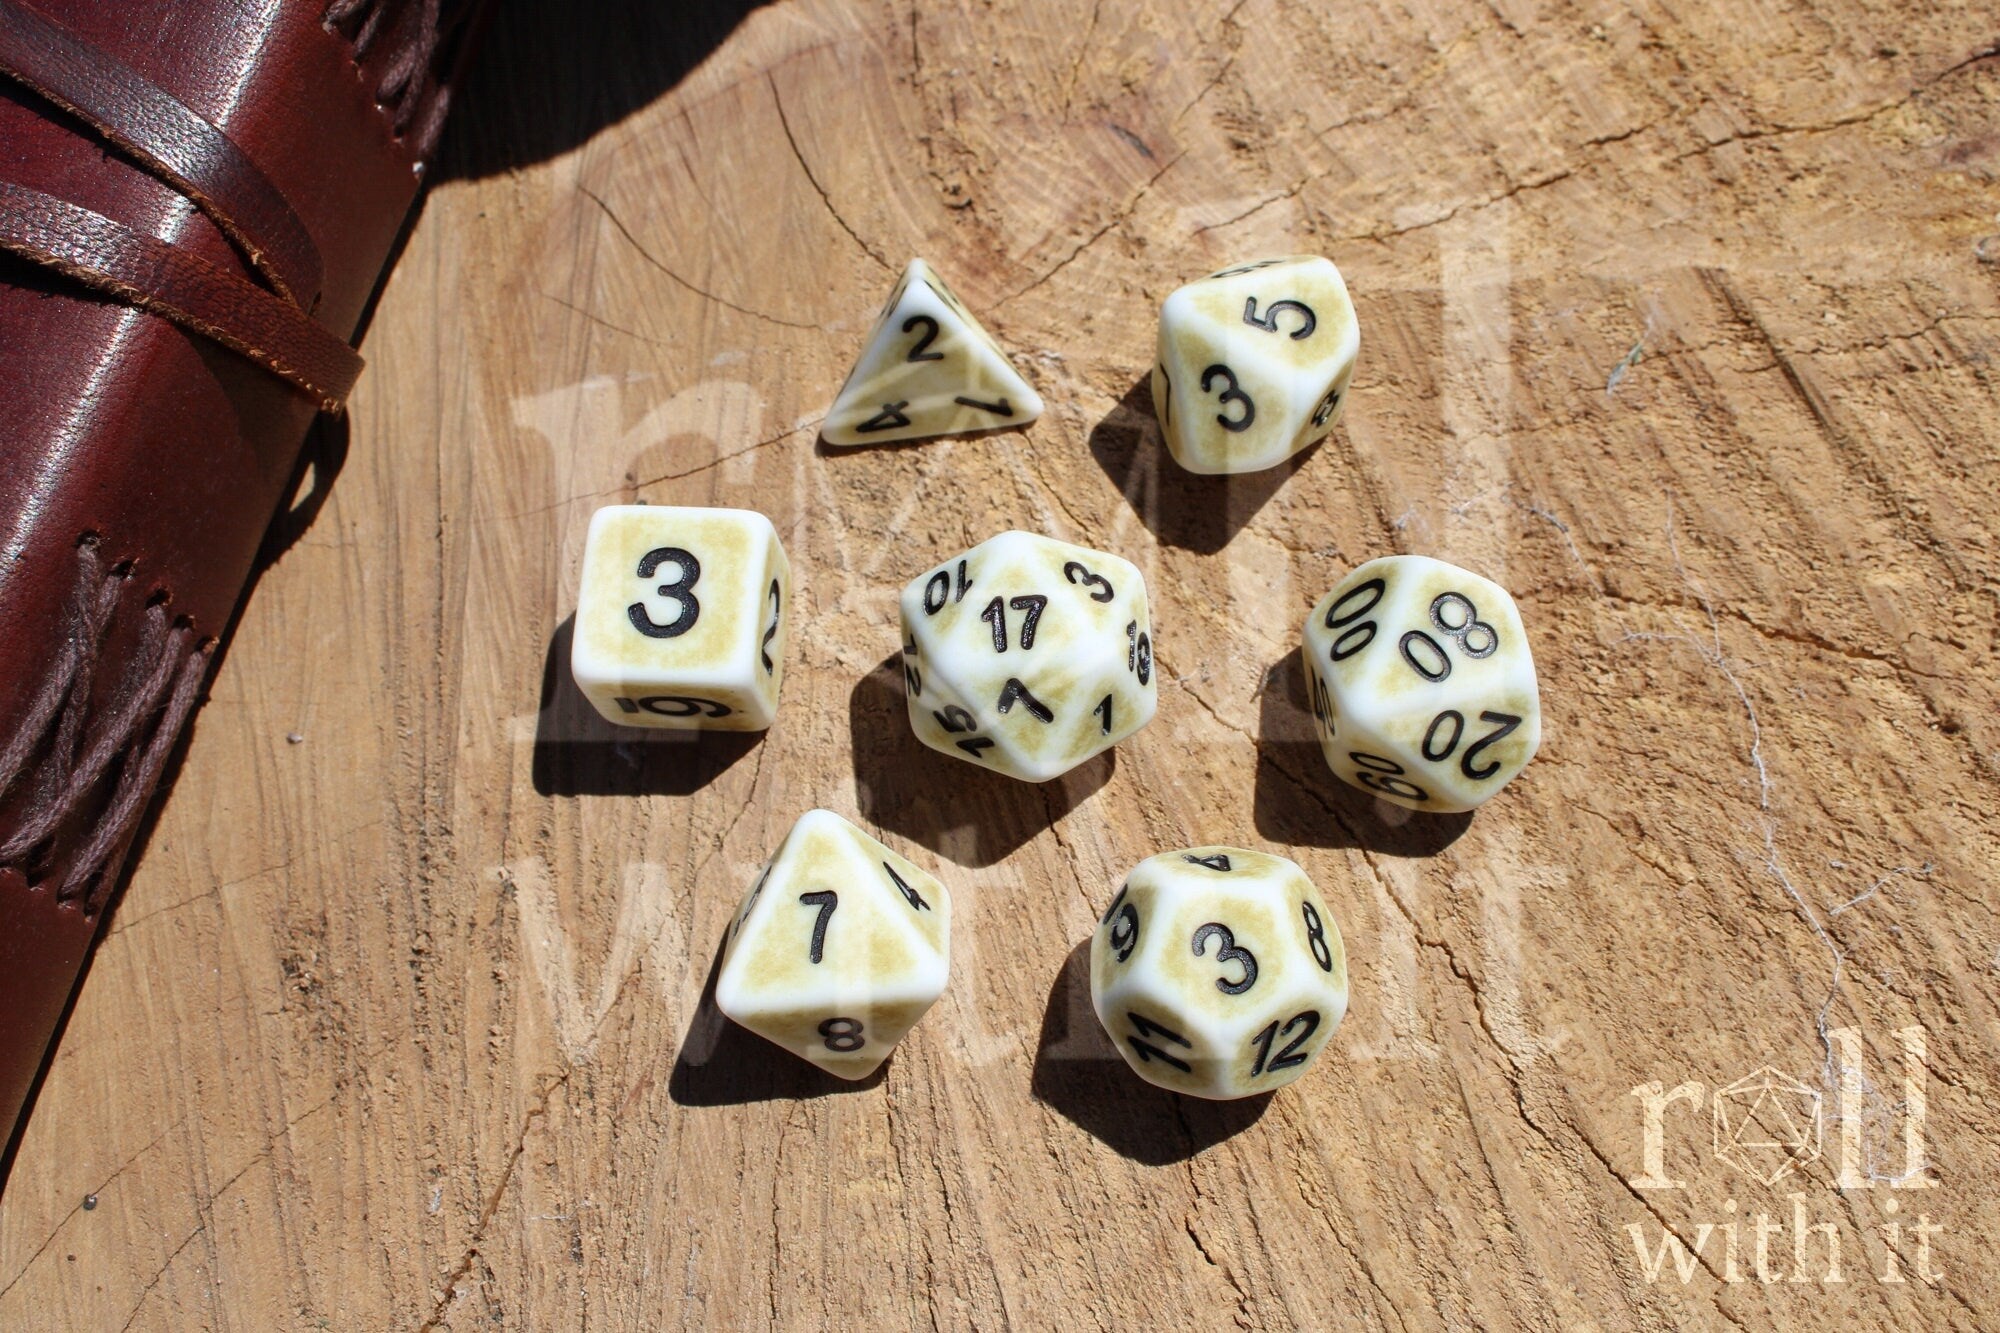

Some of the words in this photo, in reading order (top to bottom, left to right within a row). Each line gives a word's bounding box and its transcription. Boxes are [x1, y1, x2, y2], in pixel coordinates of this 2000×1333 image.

[901, 315, 945, 363] 2
[1243, 296, 1317, 341] 5
[855, 401, 911, 433] 4
[954, 396, 1014, 418] 1
[1200, 364, 1256, 433] 3
[627, 547, 701, 639] 3
[923, 559, 974, 616] 10
[1063, 561, 1115, 604] 3
[761, 578, 781, 677] 2
[981, 594, 1048, 653] 17
[1325, 578, 1386, 662] 00
[1398, 591, 1500, 684] 80
[997, 677, 1055, 724] 7
[1093, 693, 1114, 736] 1
[1421, 709, 1523, 780] 20
[882, 861, 931, 911] 4
[1181, 853, 1232, 872] 4
[798, 890, 839, 964] 7
[1302, 900, 1333, 973] 8
[1191, 921, 1259, 995] 3
[817, 1016, 866, 1052] 8
[1126, 1011, 1193, 1073] 11
[1250, 1009, 1321, 1078] 12
